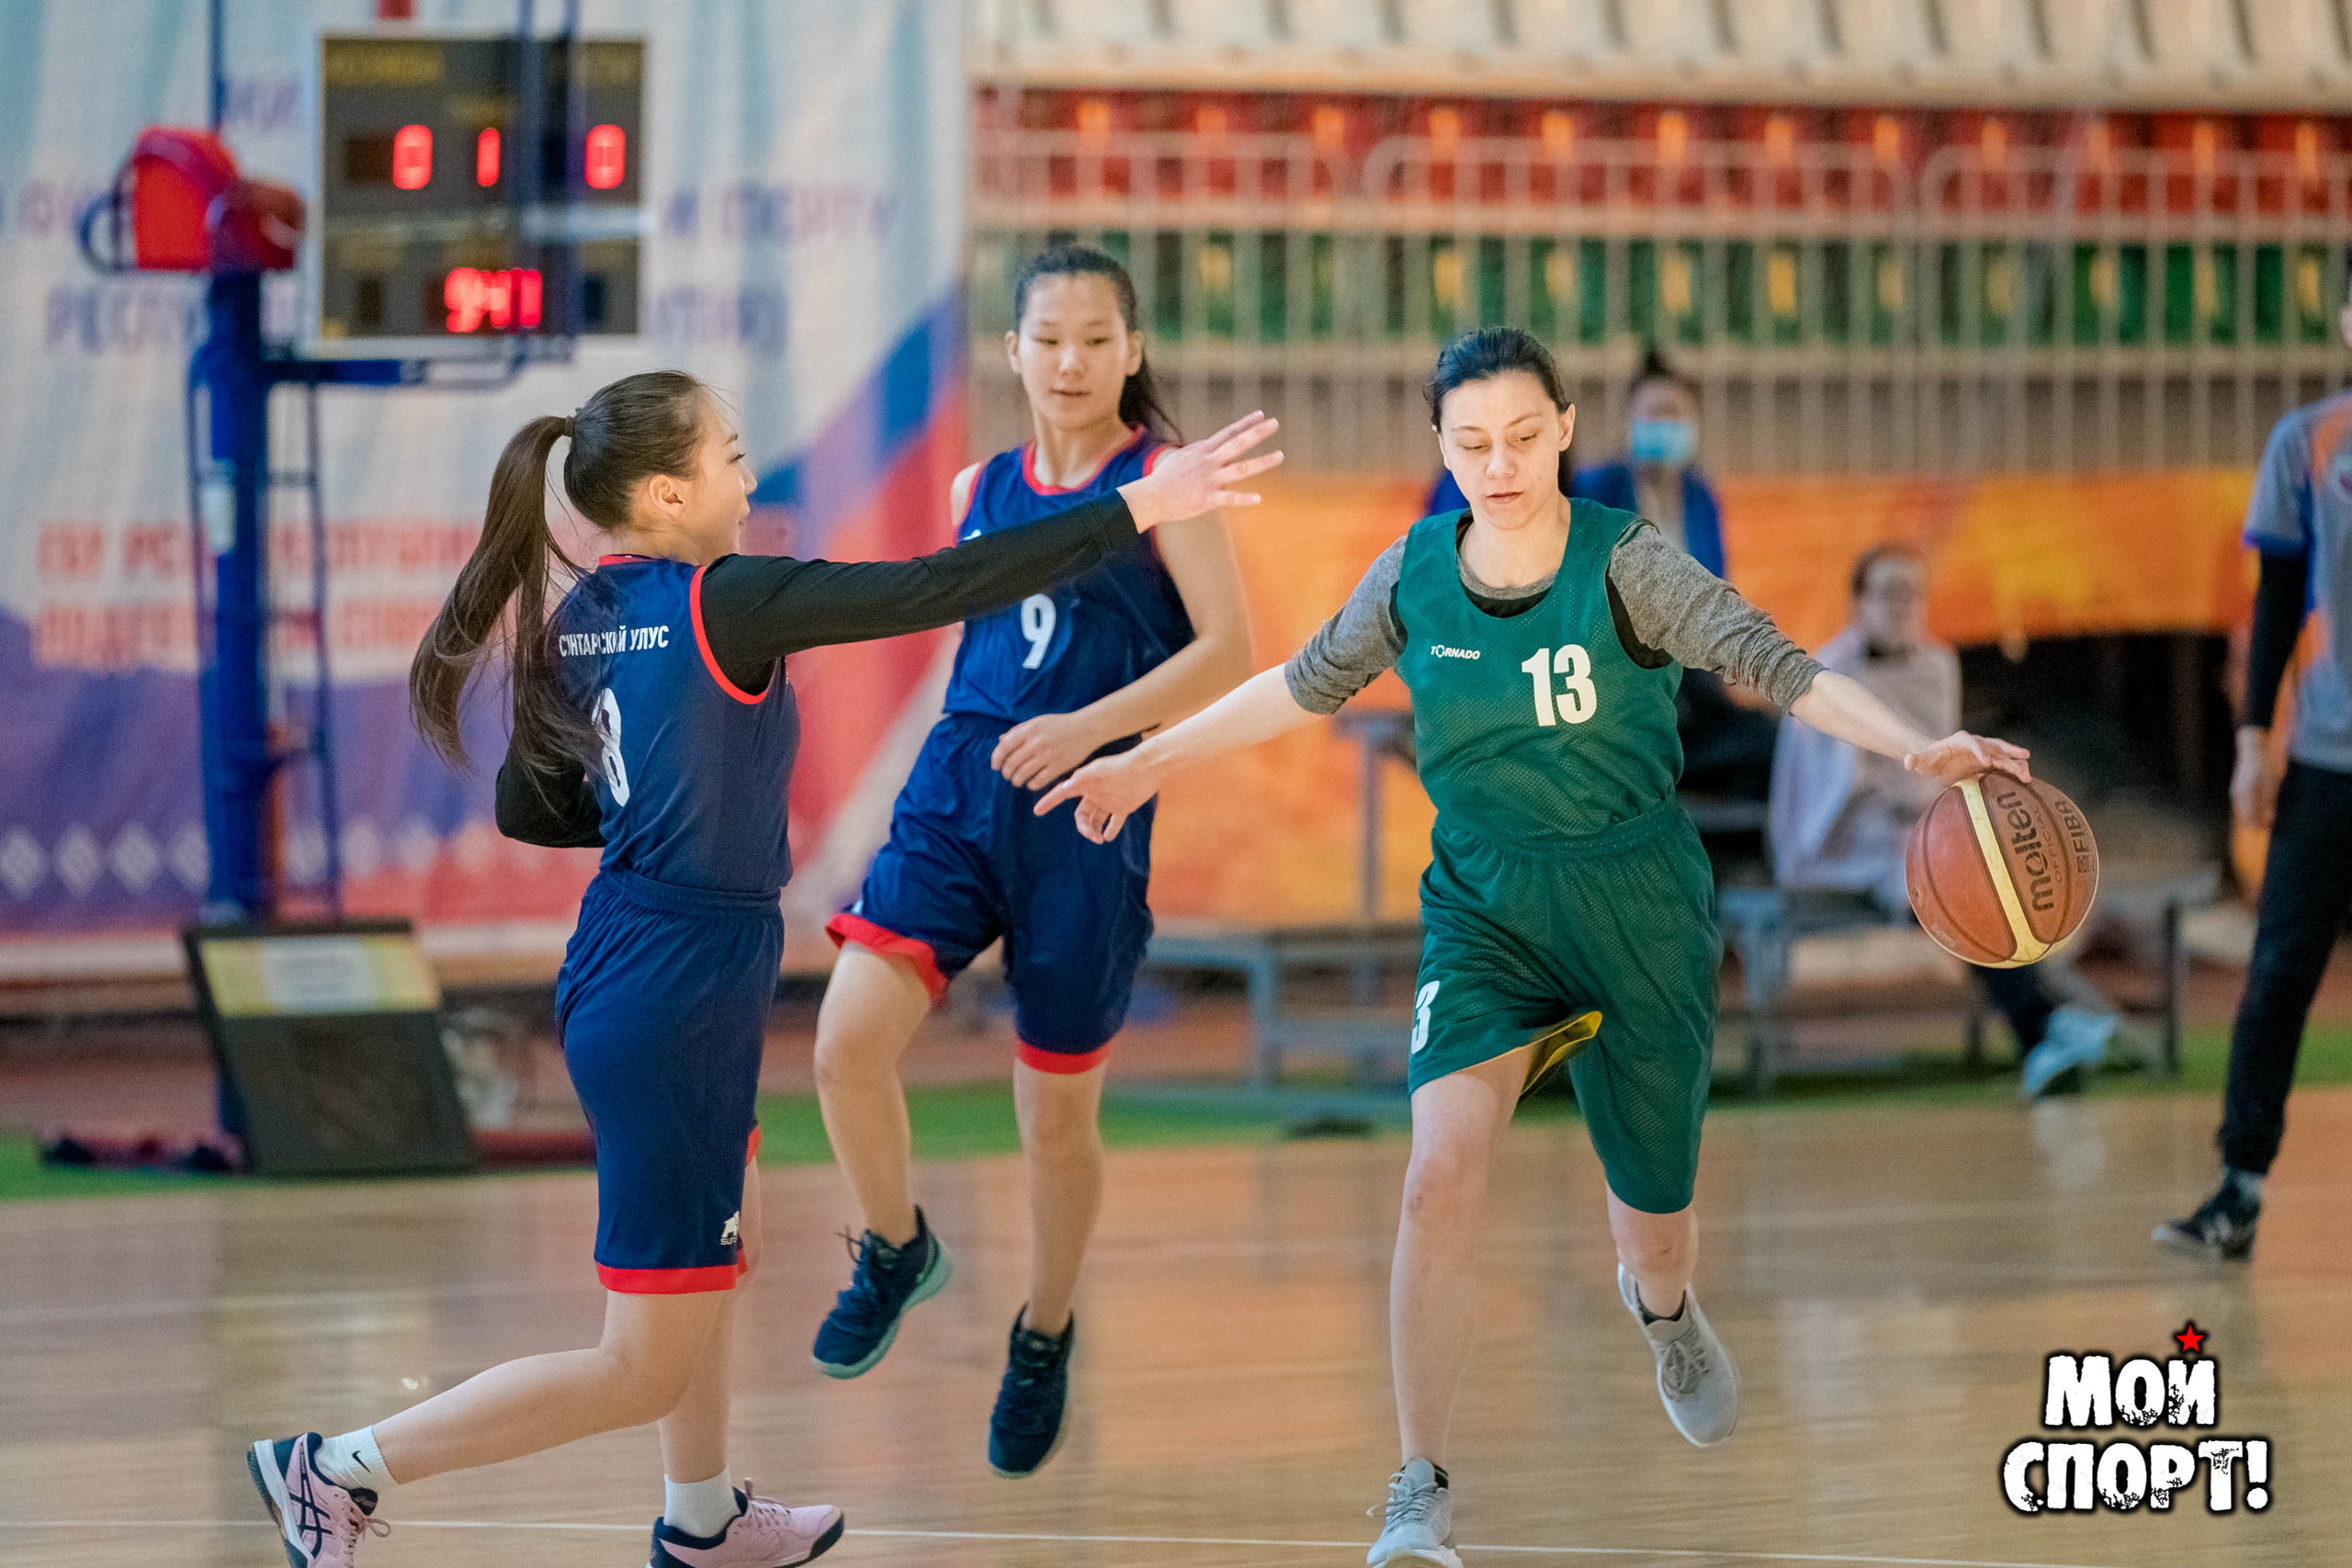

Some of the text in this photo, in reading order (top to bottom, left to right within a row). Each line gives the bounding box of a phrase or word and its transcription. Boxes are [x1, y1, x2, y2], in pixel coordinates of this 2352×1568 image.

[629, 625, 669, 650] УЛУС
[1021, 593, 1056, 669] 9
[1430, 645, 1481, 660] TORNADO
[1521, 644, 1598, 727] 13
[1996, 791, 2054, 911] molten
[2054, 800, 2089, 852] FIBA
